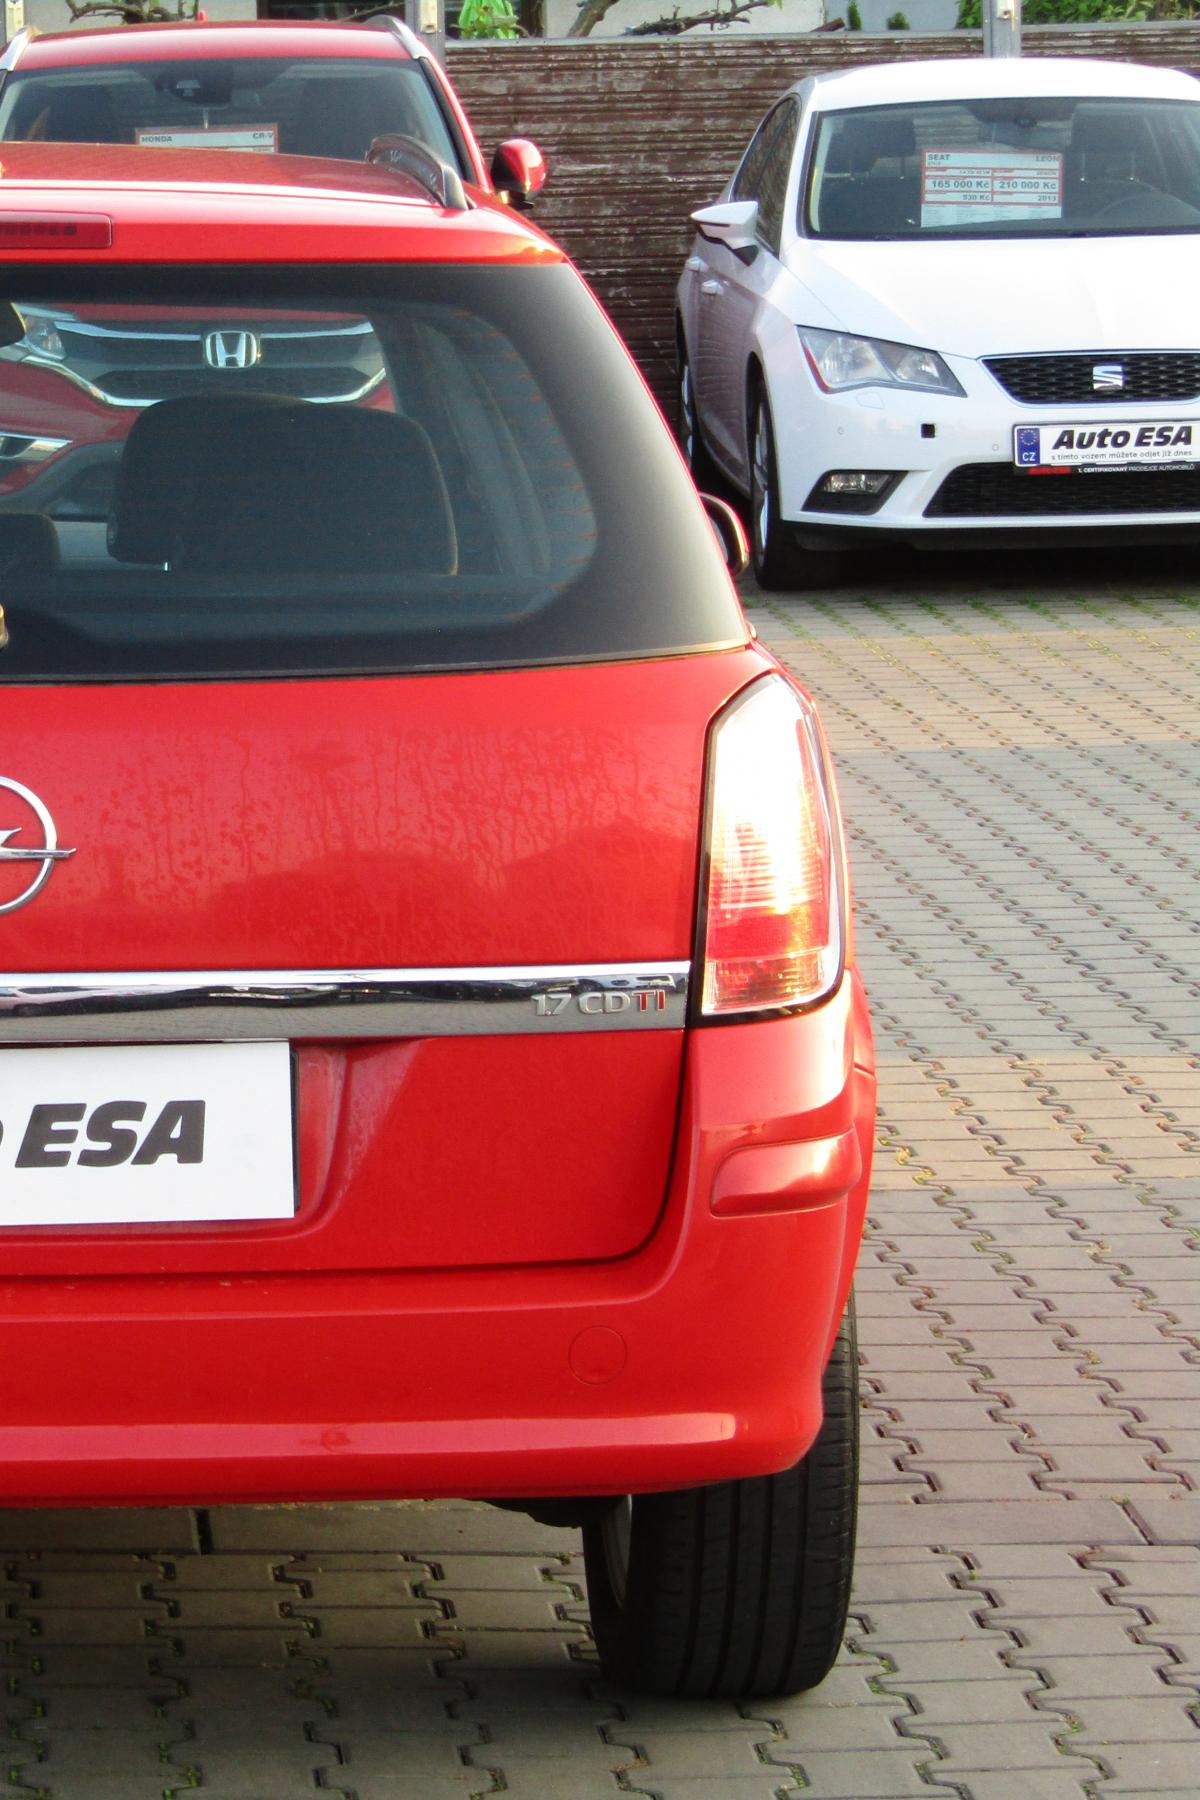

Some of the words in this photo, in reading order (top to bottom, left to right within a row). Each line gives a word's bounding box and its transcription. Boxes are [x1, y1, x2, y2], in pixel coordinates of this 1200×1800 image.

[141, 135, 173, 143] HONDA
[932, 180, 950, 189] 165
[953, 180, 973, 189] 000
[975, 178, 990, 189] Kč
[998, 180, 1018, 189] 210
[1021, 180, 1040, 190] 000
[1042, 179, 1057, 190] Kč
[979, 193, 990, 201] Kč
[1052, 428, 1131, 450] Auto
[1134, 426, 1193, 447] ESA
[1022, 451, 1036, 462] CZ
[1081, 452, 1107, 460] vozem
[1139, 449, 1161, 459] odjet
[1173, 448, 1193, 457] dnes
[531, 991, 572, 1016] 1.7
[578, 989, 666, 1014] CDTI
[14, 1099, 206, 1169] ESA
